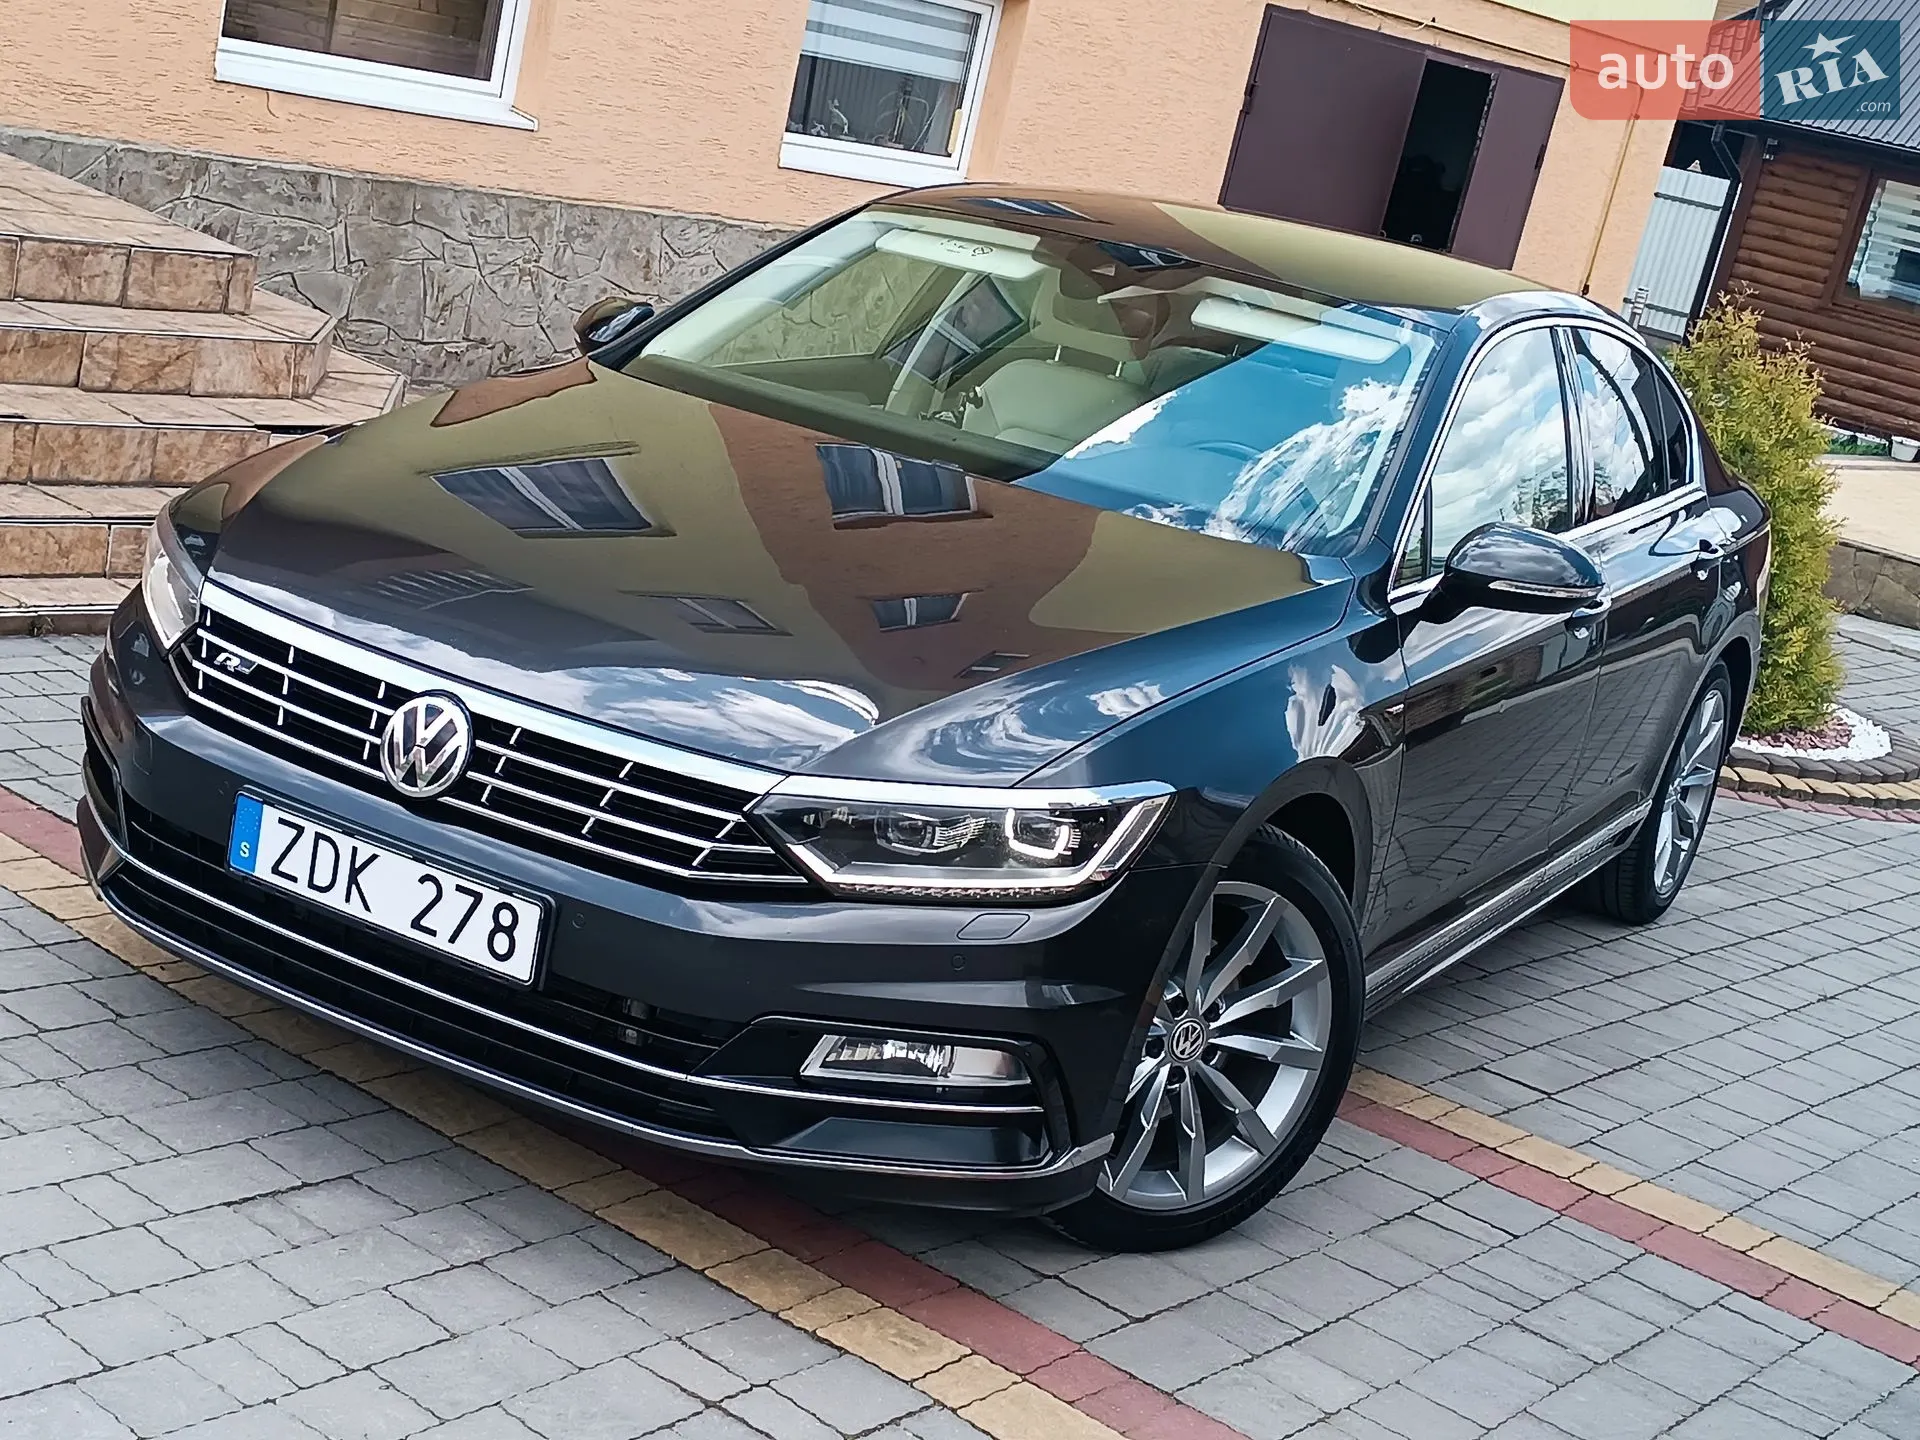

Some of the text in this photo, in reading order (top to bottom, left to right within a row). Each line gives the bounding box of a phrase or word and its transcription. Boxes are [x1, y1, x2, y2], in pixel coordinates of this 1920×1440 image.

[239, 841, 251, 858] S
[270, 817, 519, 963] ZDK 278
